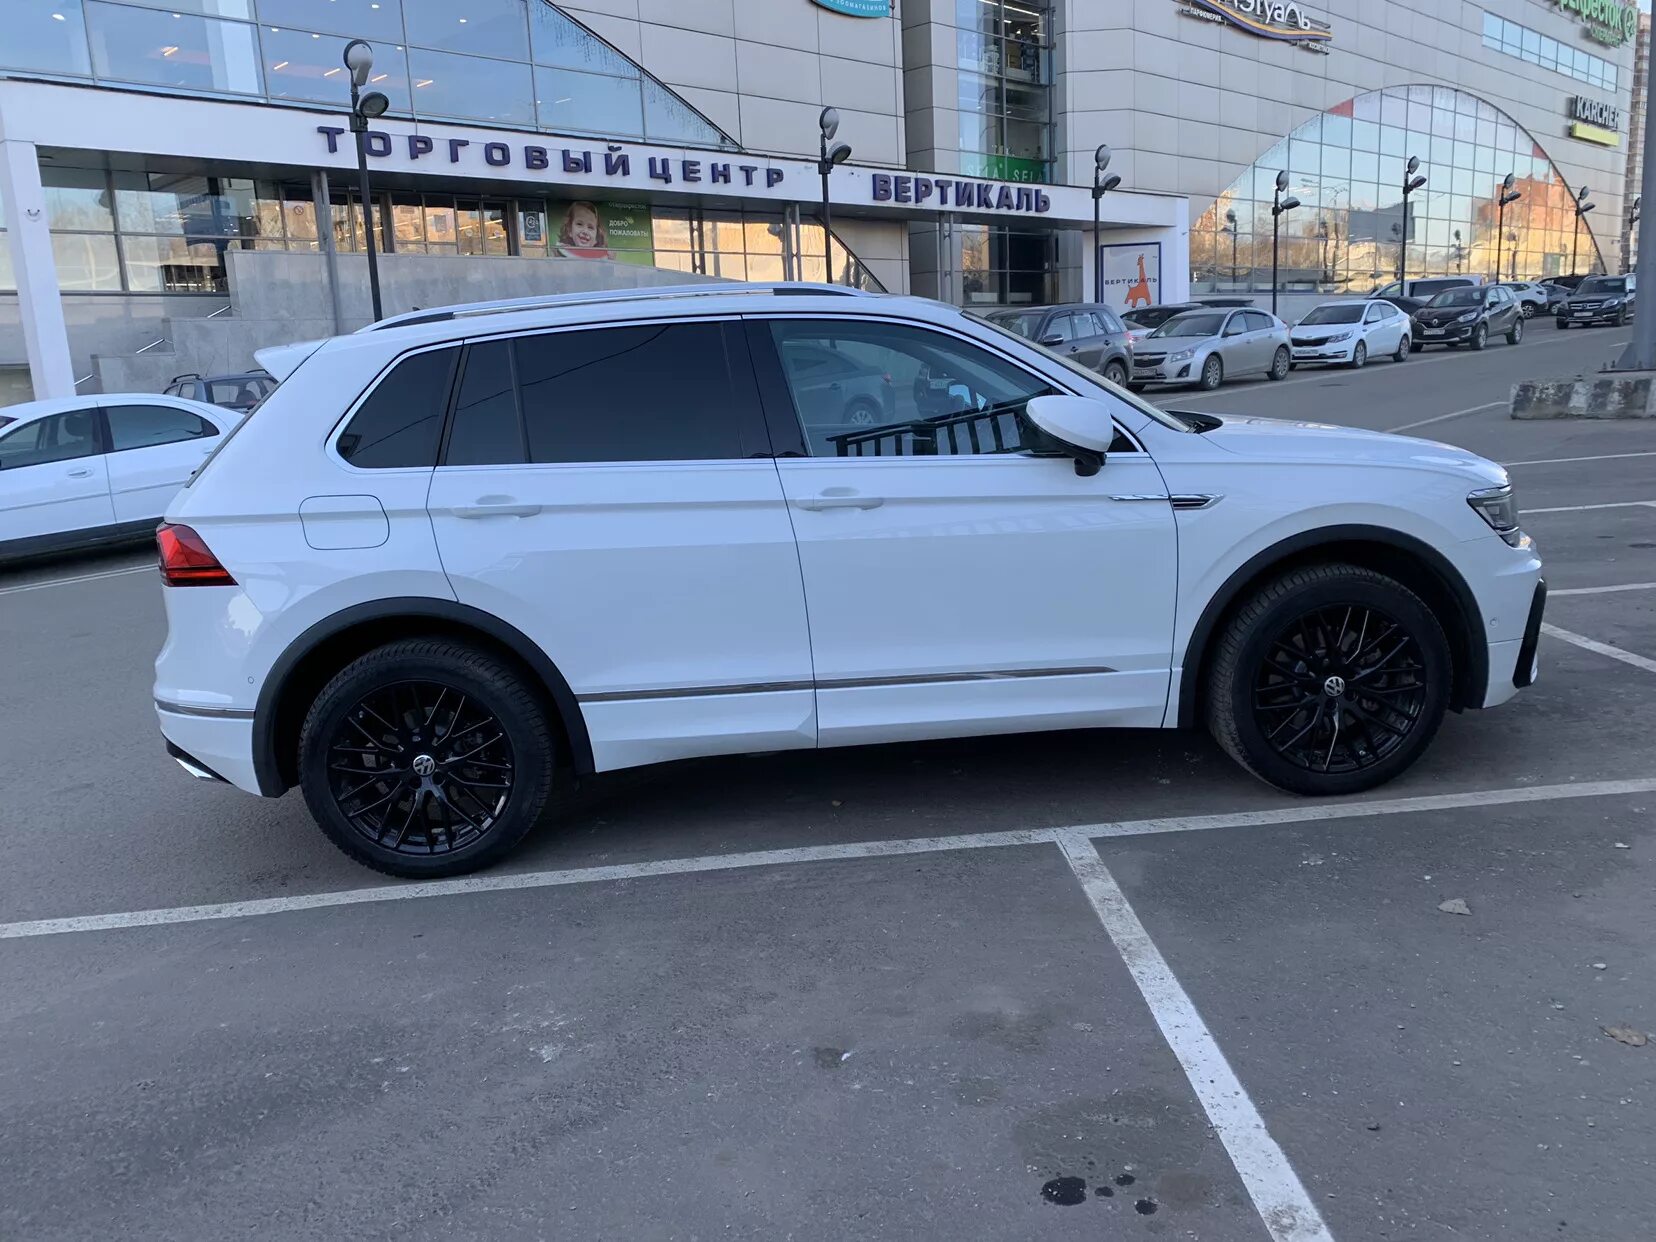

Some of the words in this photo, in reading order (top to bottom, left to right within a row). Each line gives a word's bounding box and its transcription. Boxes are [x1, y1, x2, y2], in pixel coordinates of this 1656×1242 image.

[317, 126, 631, 176] ТОРГОВЫЙ
[648, 156, 785, 188] ЦЕНТР
[872, 173, 1051, 213] ВЕРТИКАЛЬ
[1104, 277, 1158, 286] ВЕРТИКАЛЬ
